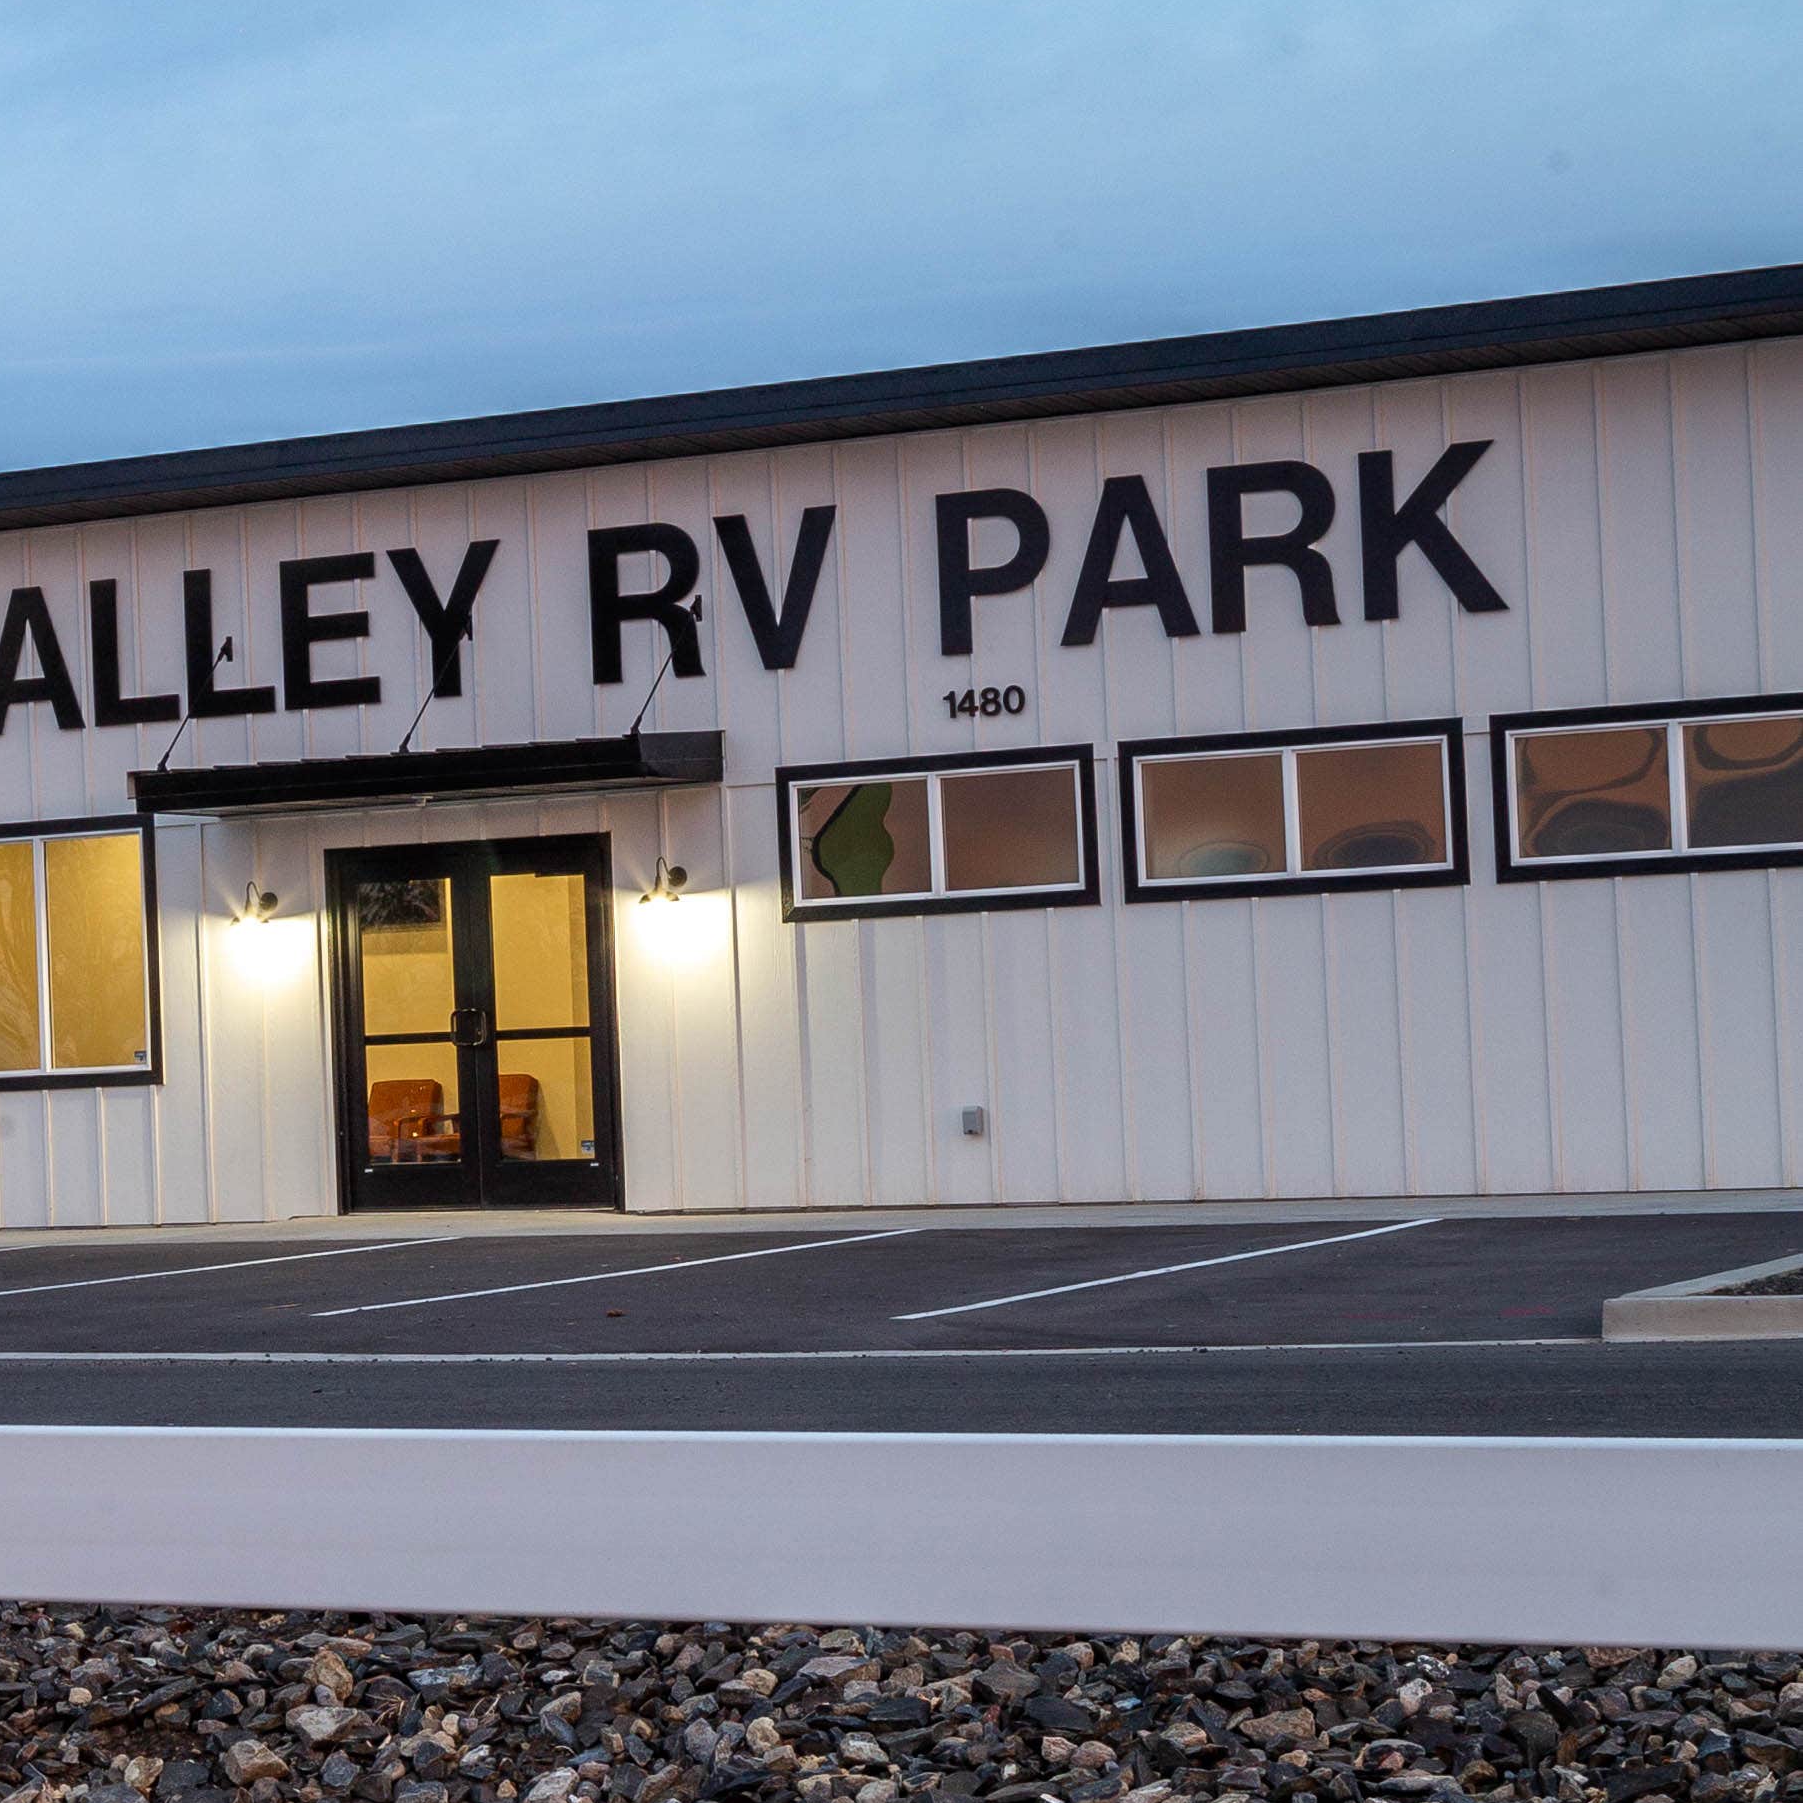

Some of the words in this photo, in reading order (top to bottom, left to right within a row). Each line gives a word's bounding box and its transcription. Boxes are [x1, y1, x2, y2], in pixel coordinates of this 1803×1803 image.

[587, 504, 838, 686] RV
[935, 439, 1510, 656] PARK
[942, 684, 1026, 719] 1480
